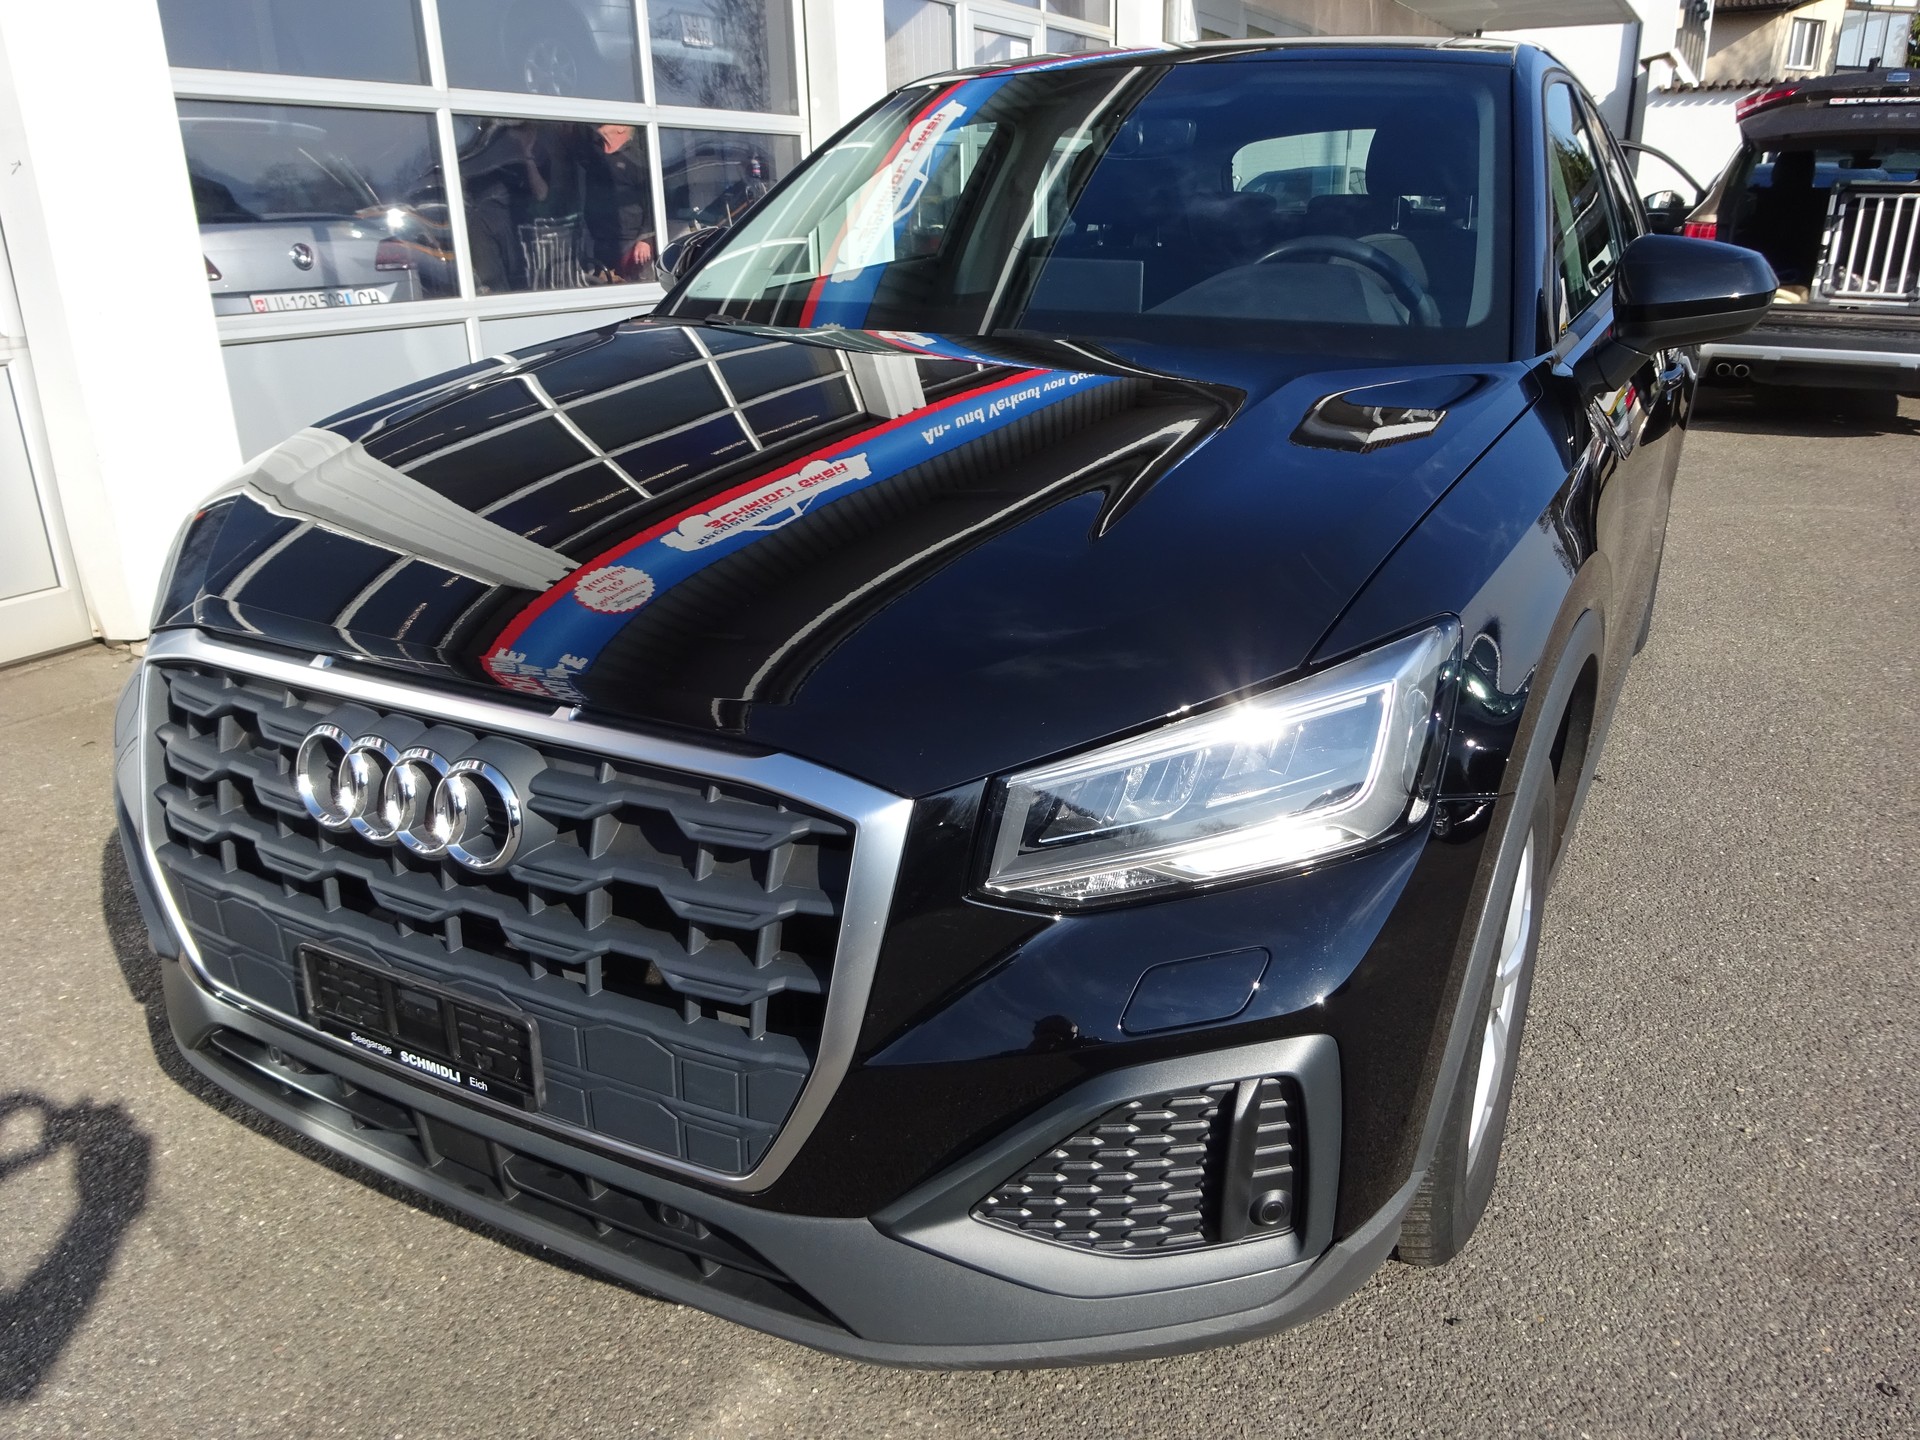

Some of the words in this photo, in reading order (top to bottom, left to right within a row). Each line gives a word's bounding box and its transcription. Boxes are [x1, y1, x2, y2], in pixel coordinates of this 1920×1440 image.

[350, 1031, 393, 1055] Seegarage
[400, 1050, 461, 1083] SCHMIDLI
[469, 1076, 488, 1091] Eich
